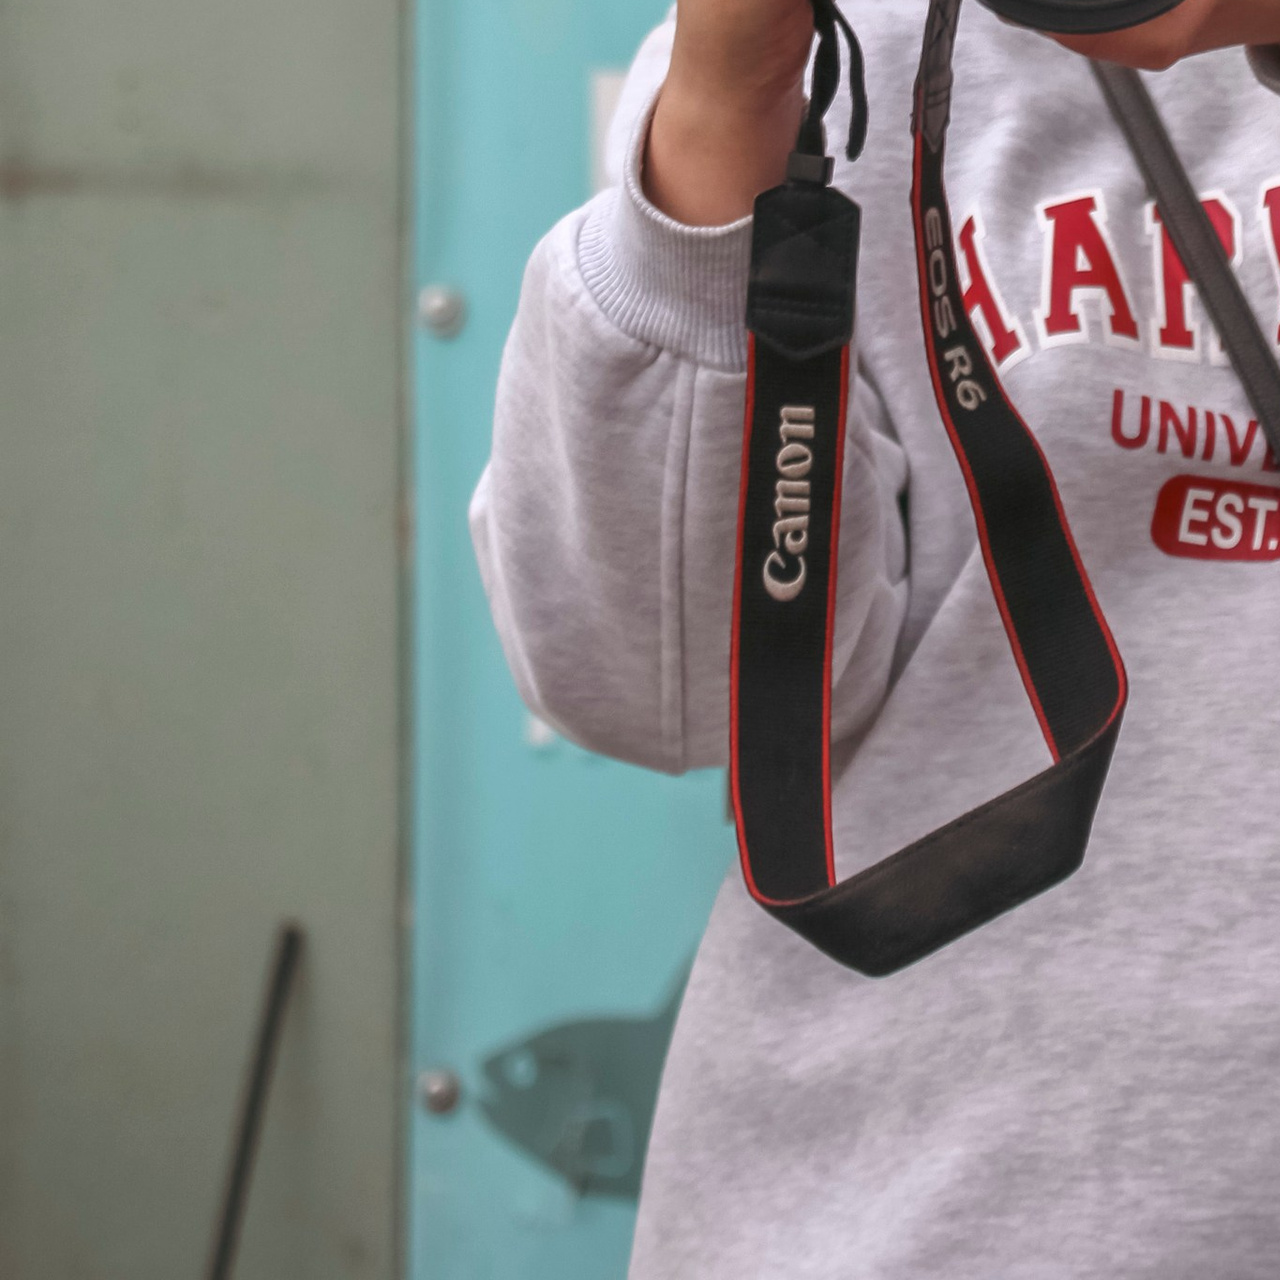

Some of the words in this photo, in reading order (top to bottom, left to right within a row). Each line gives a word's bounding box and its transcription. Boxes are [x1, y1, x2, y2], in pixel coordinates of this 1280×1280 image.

[924, 206, 958, 339] EOS
[944, 344, 988, 412] R6
[762, 405, 816, 603] Canon
[1177, 487, 1280, 551] EST.
